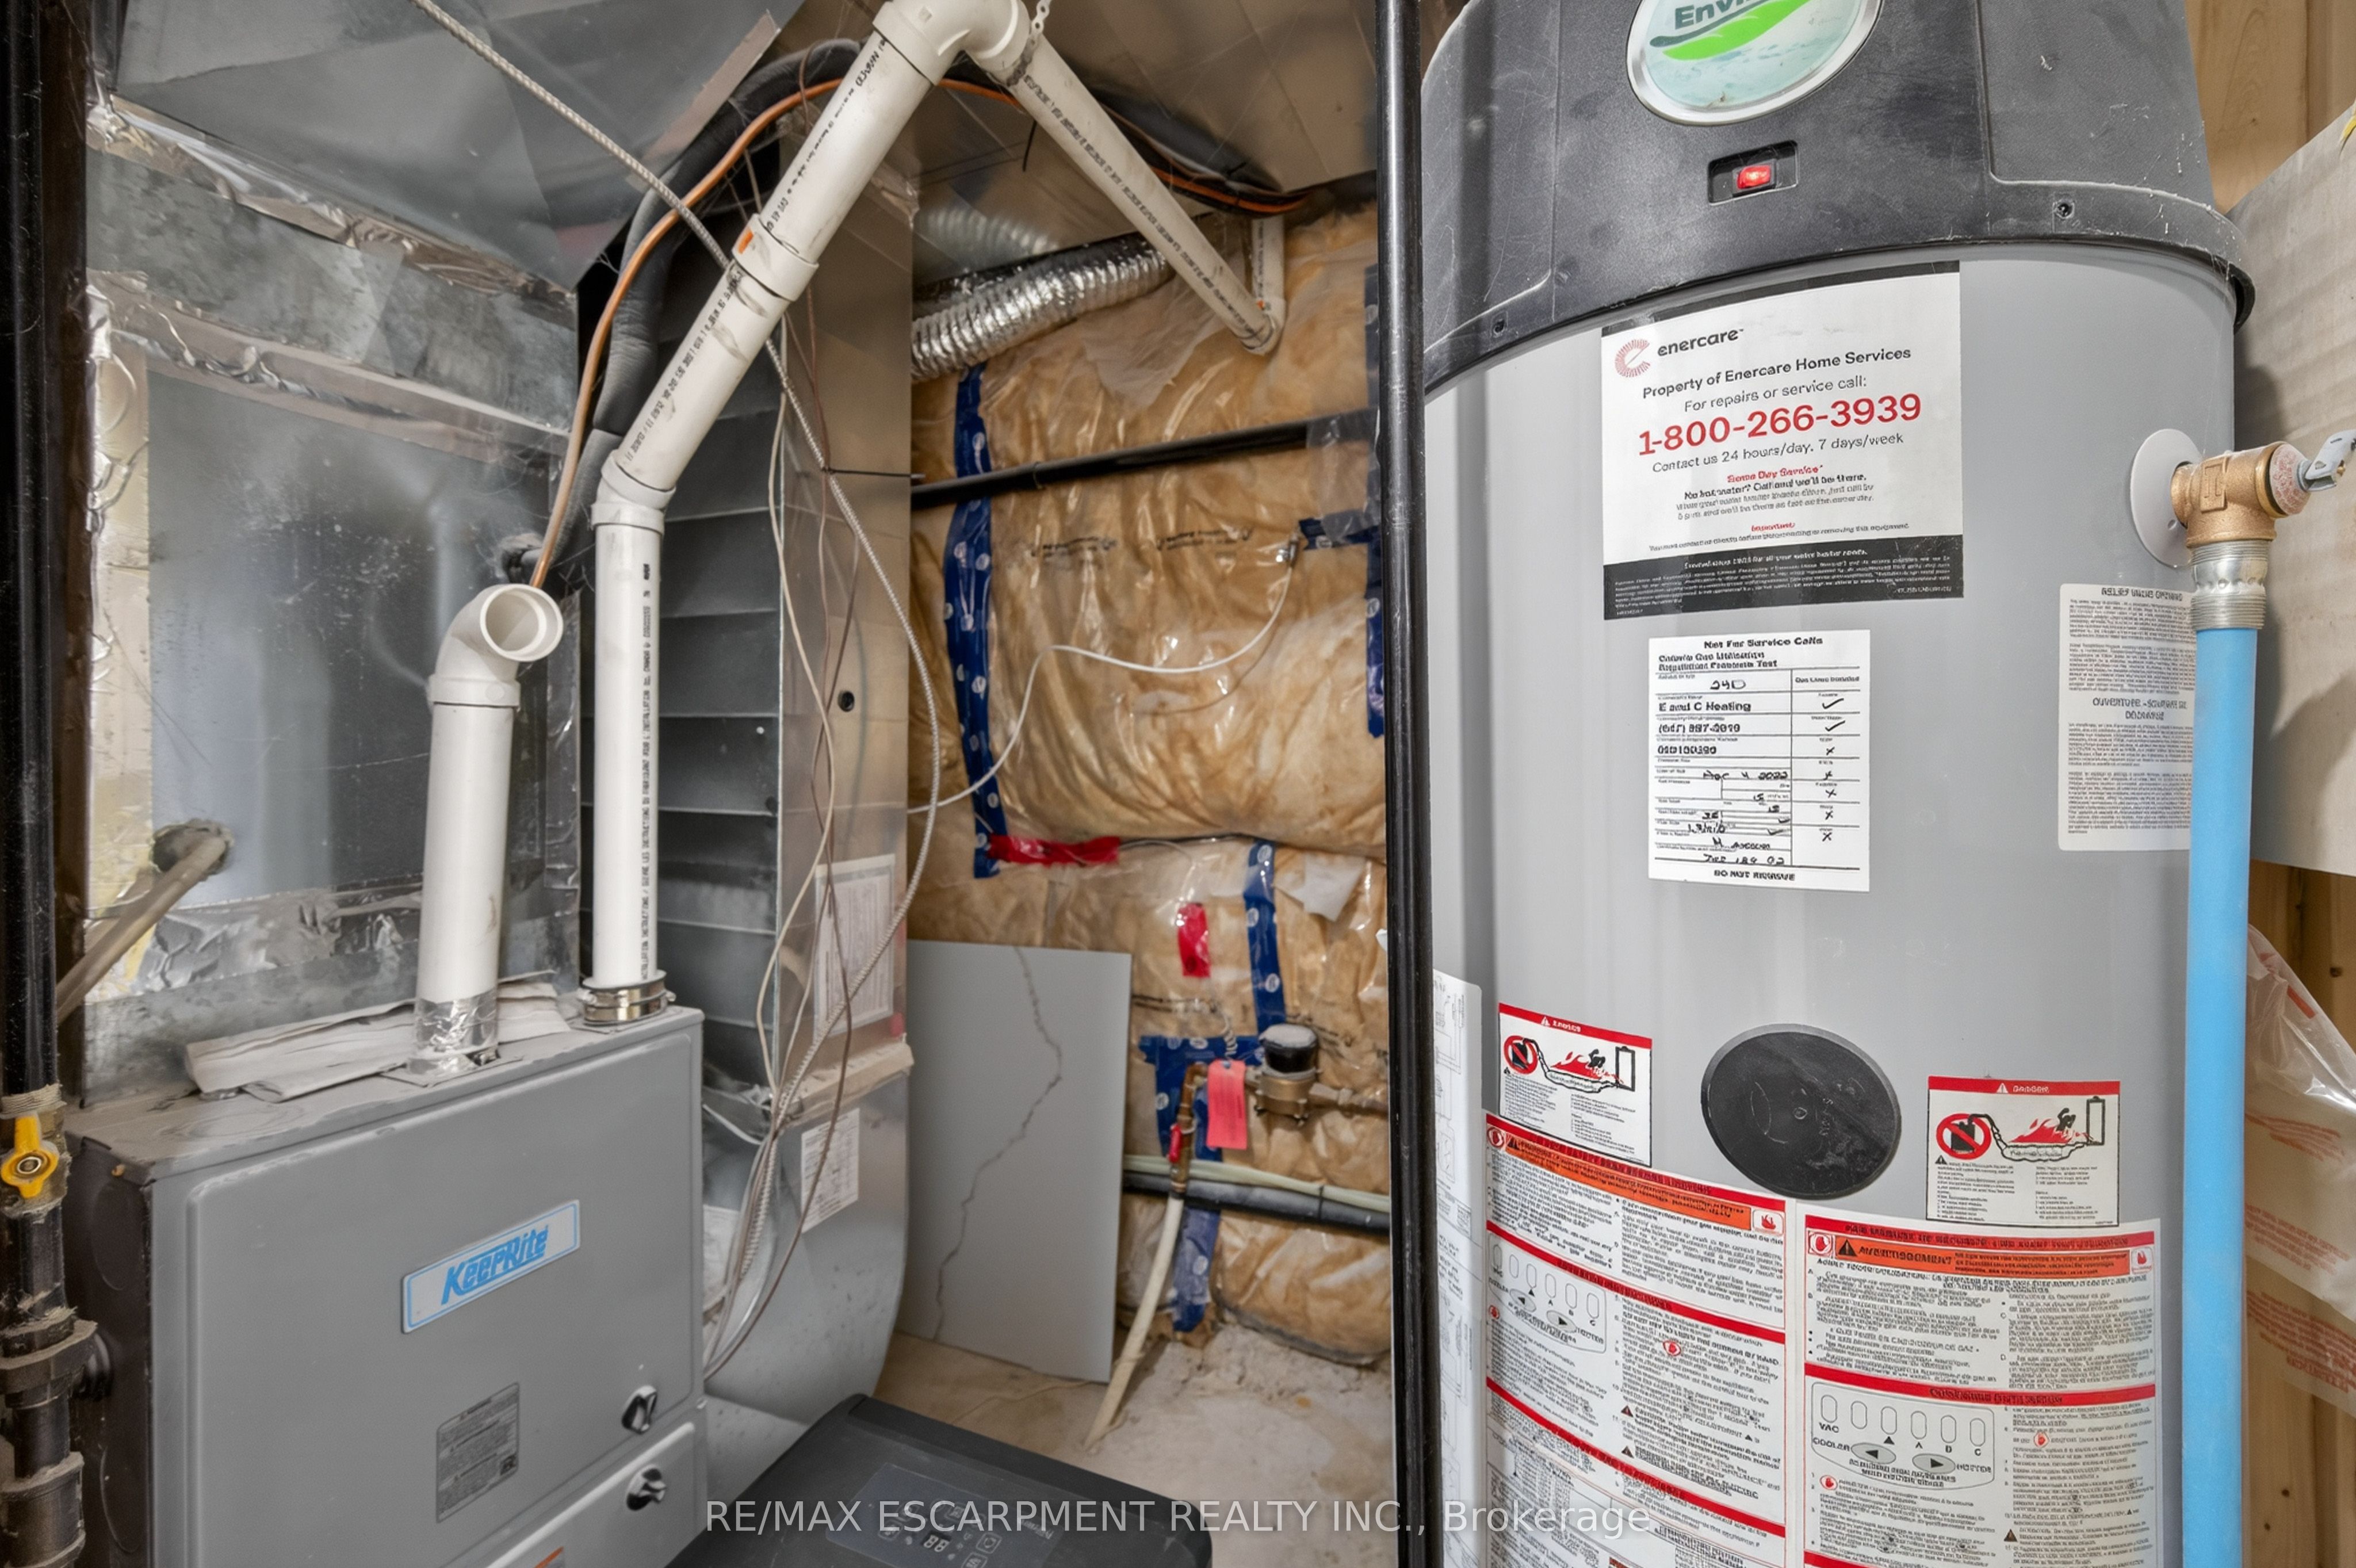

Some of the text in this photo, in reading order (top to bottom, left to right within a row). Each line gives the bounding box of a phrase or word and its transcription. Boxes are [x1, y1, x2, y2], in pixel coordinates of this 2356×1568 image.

[1657, 328, 1740, 357] enercare
[1643, 347, 1911, 399] Property of Enercare Home Services
[1685, 375, 1867, 412] For repairs or service call:
[1639, 393, 1921, 456] 1-800-266-3939
[1653, 456, 1700, 473] Contact
[1704, 454, 1718, 465] us
[1722, 450, 1738, 462] 24
[1819, 439, 1827, 450] 7
[1831, 433, 1904, 450] days/week
[1818, 1422, 1839, 1433] VAC
